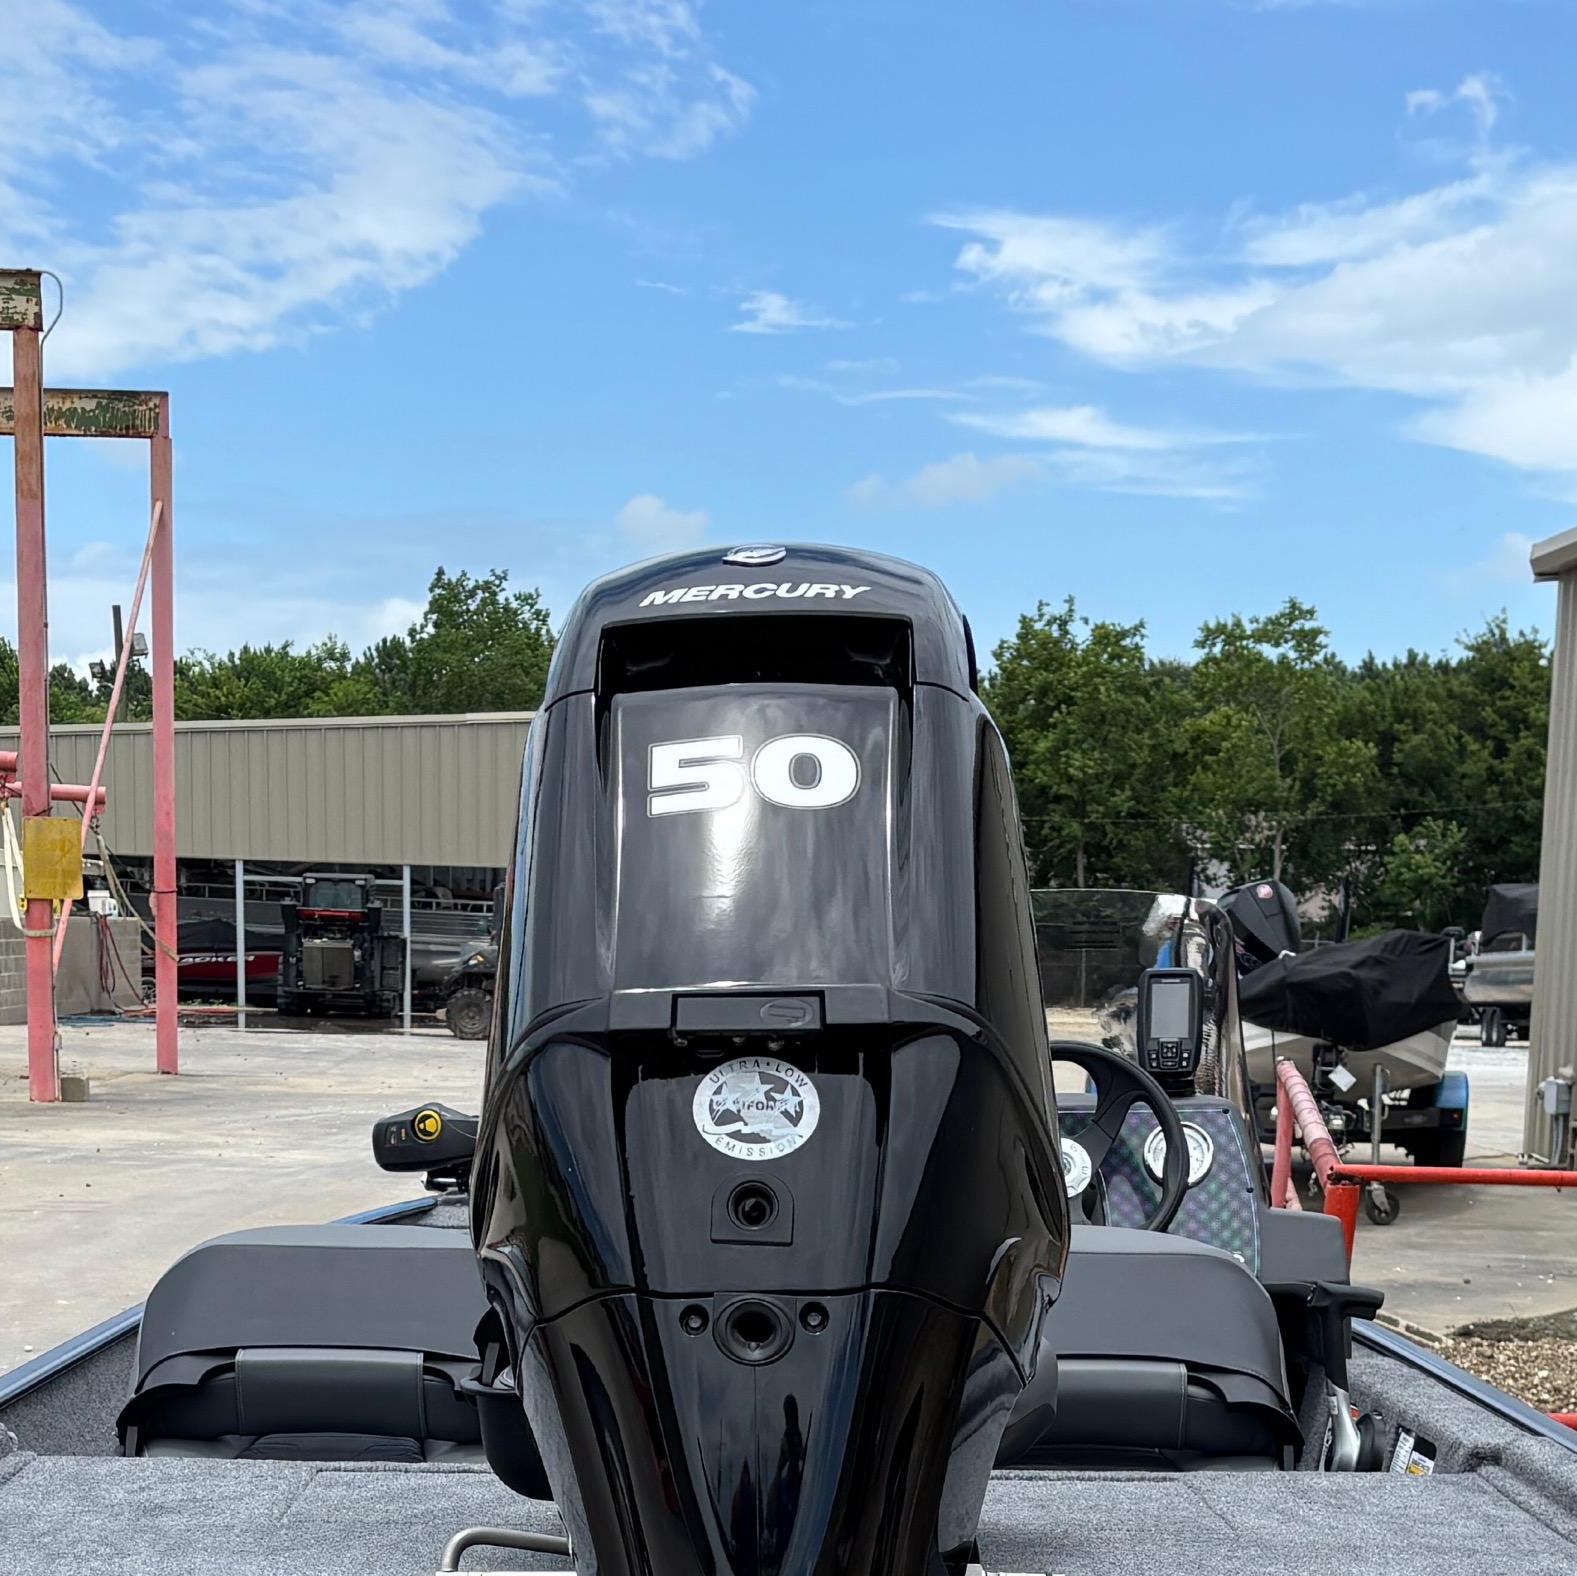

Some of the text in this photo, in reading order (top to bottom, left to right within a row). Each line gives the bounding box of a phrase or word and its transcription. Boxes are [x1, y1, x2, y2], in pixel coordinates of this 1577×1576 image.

[638, 582, 872, 608] MERCURY
[647, 732, 862, 818] 50
[775, 1063, 808, 1088] LOW
[715, 1136, 798, 1157] EMISSION
